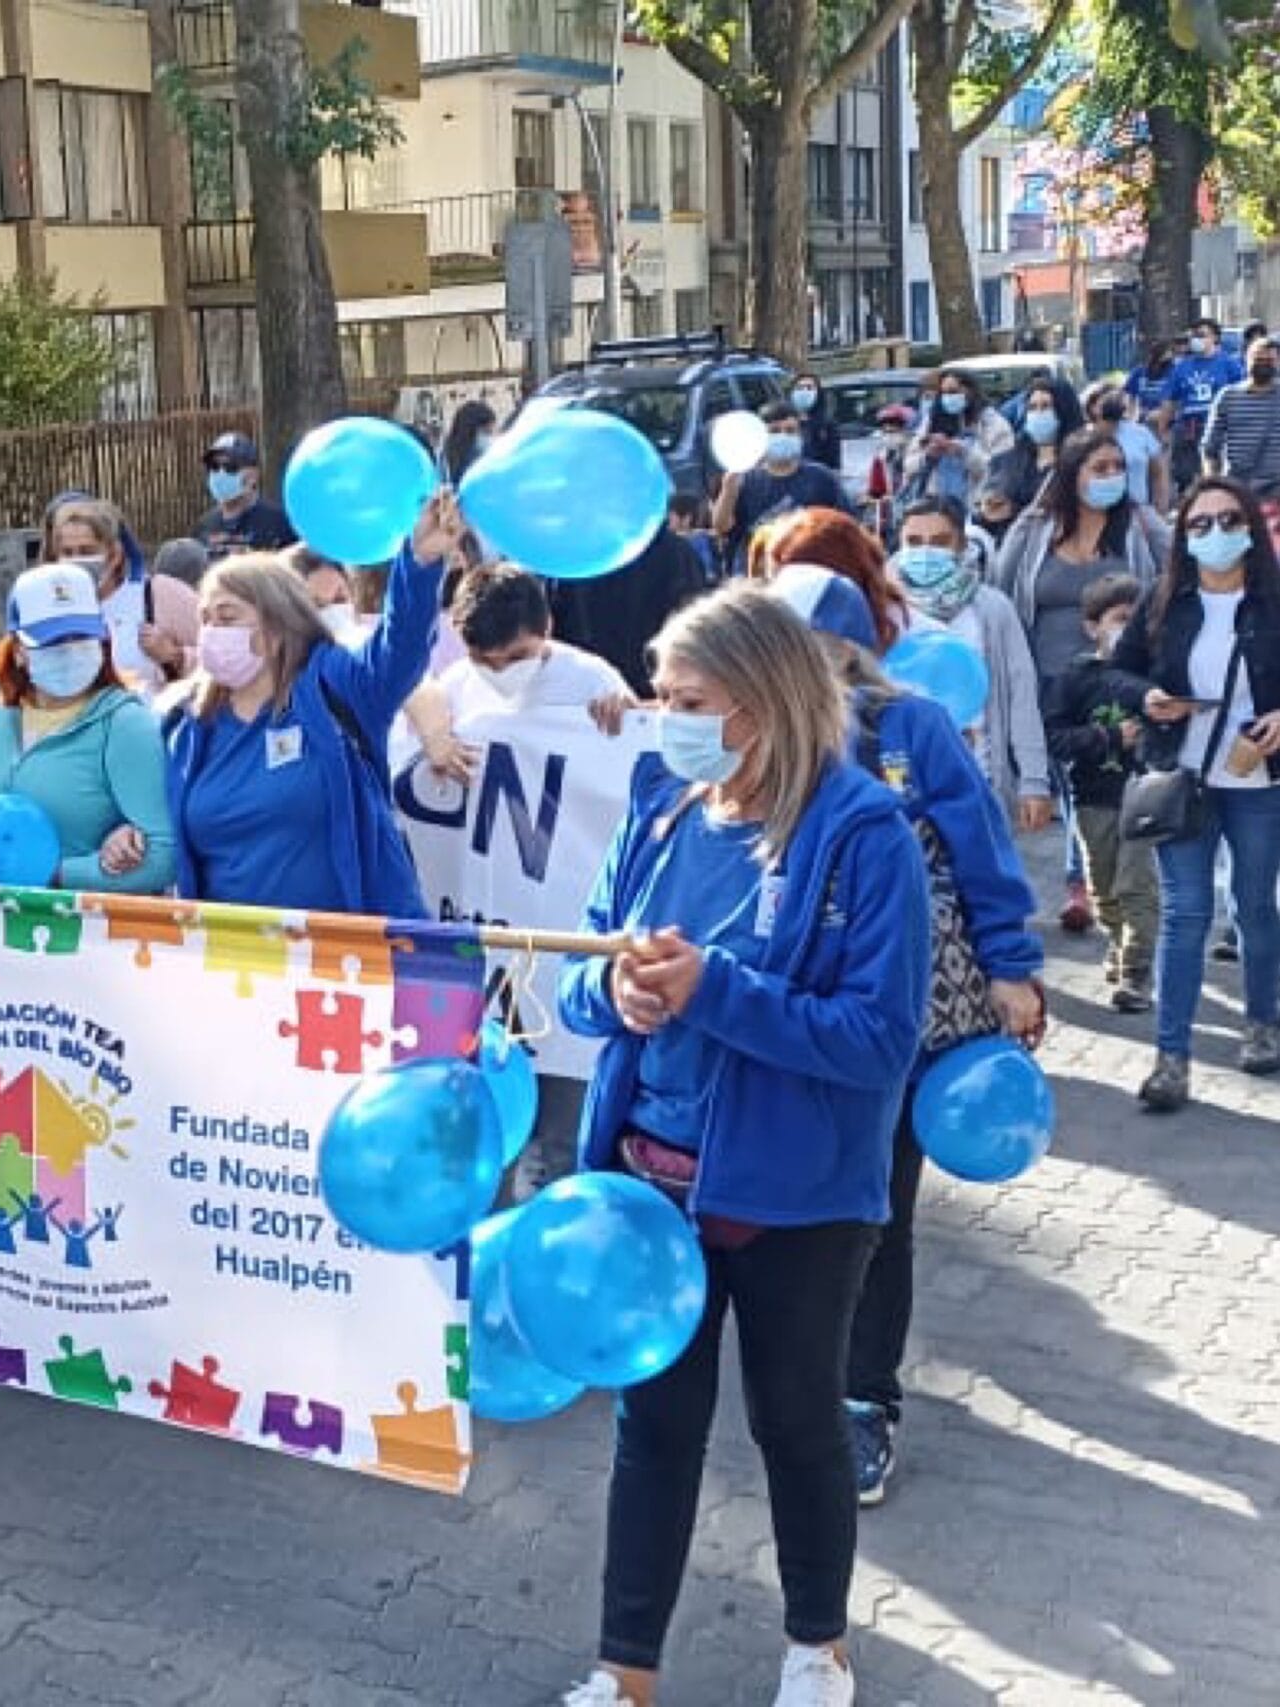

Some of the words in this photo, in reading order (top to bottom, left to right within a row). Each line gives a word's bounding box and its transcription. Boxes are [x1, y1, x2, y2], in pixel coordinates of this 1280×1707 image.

[15, 1029, 52, 1052] DEL
[83, 1019, 125, 1060] TEA
[169, 1105, 310, 1151] Fundada
[169, 1151, 207, 1182] de
[190, 1198, 239, 1231] del
[250, 1207, 326, 1244] 2017
[215, 1243, 353, 1295] Hualpén
